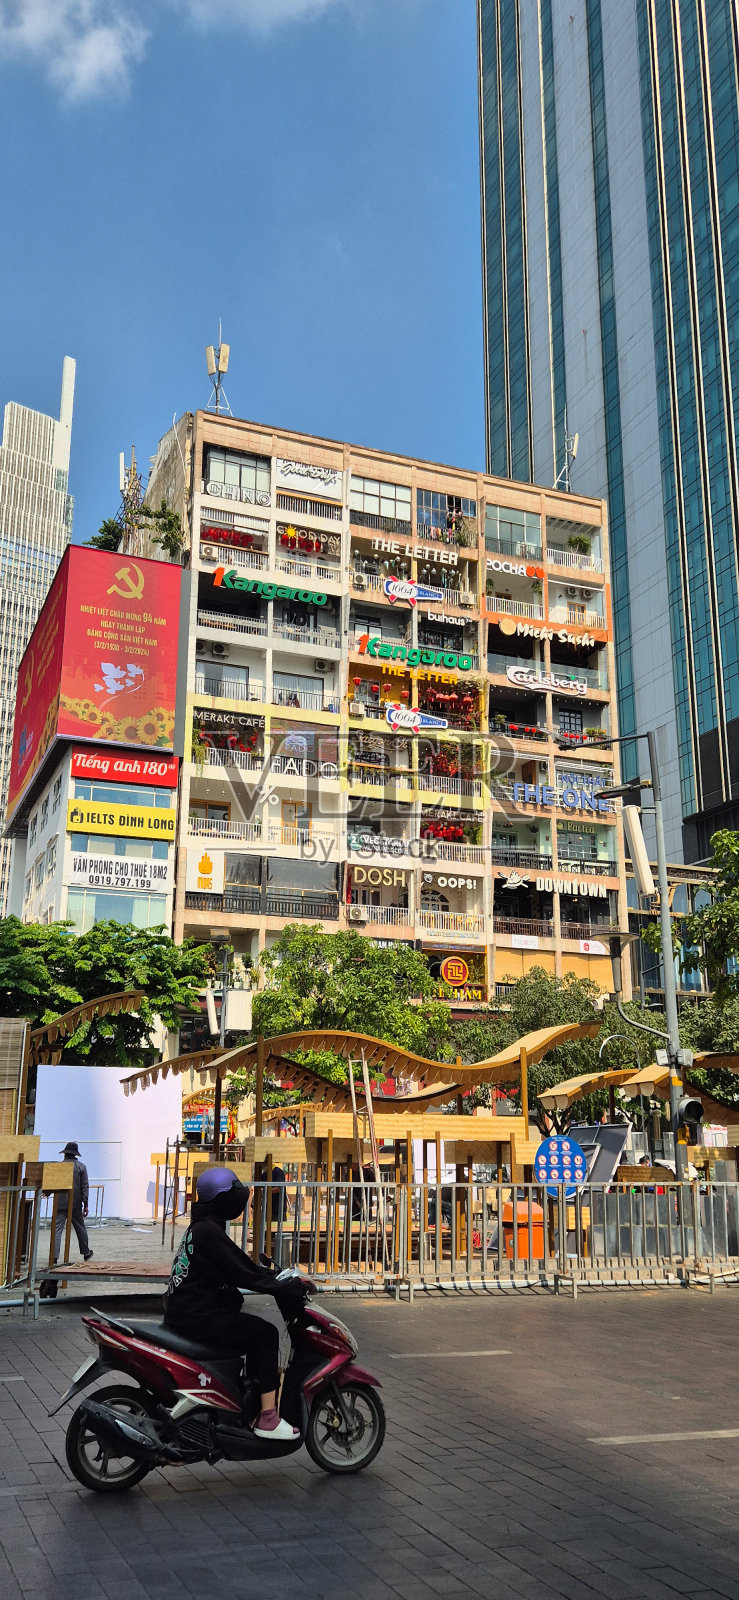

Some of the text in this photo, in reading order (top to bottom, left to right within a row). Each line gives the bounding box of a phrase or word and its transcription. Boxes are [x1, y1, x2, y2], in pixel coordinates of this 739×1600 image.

[319, 533, 341, 545] DAY
[372, 536, 459, 566] THE LETTER
[391, 583, 413, 596] 1664
[142, 612, 153, 624] 94
[516, 622, 595, 647] Michi Sushi
[381, 663, 458, 685] THE LETTER
[506, 665, 588, 696] Carlsberg
[193, 710, 266, 729] MERAKI CAFÉ
[394, 711, 416, 724] 1664
[73, 753, 110, 774] Tiếng
[113, 760, 141, 774] anh
[142, 761, 168, 776] 180
[270, 755, 339, 780] FADO
[513, 782, 610, 812] THE ONE
[86, 812, 174, 831] IELTS ĐÌNH LONG
[421, 808, 458, 821] MERAKI
[73, 855, 168, 880] VĂN PHÒNG CHO THUÊ 18M2
[354, 866, 406, 888] DOSH
[88, 875, 151, 889] 0919.797.199
[437, 876, 477, 890] OOPS!
